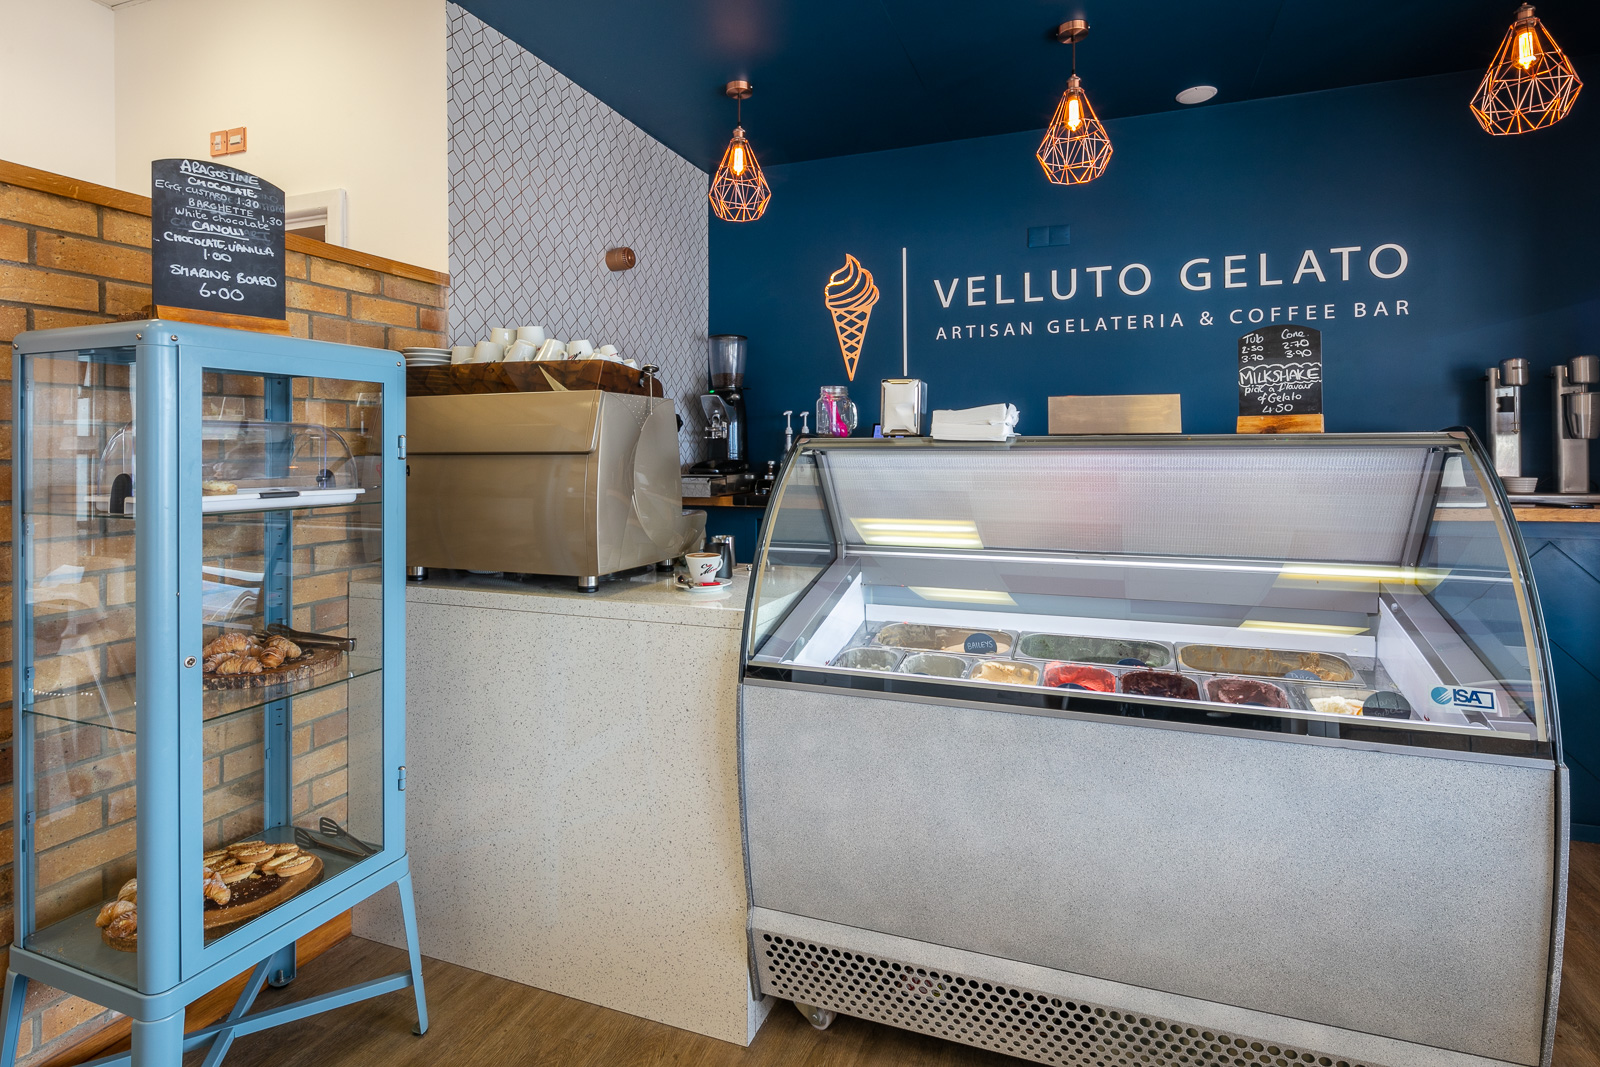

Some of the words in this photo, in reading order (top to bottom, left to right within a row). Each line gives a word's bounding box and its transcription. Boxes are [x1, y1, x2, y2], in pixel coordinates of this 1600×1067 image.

[180, 159, 260, 185] ARAGOSTINE
[155, 179, 181, 191] EGG
[185, 186, 228, 202] CUSTARD
[237, 197, 260, 209] 1.30
[175, 206, 209, 220] White
[212, 214, 271, 231] chocolate
[261, 214, 283, 227] 1.30
[203, 248, 233, 262] 1.00
[169, 263, 232, 282] SHARING
[236, 272, 278, 288] BOARD
[933, 262, 1152, 309] VELLUTO
[1179, 242, 1409, 292] GELATO
[199, 282, 245, 301] 6.00
[935, 320, 1033, 341] ARTISAN
[1046, 312, 1184, 335] GELATERIA
[1199, 310, 1214, 326] &
[1229, 303, 1336, 325] COFFEE
[1354, 299, 1410, 318] BAR
[1242, 333, 1264, 344] Tub
[1241, 354, 1264, 363] 3.70
[1284, 348, 1312, 358] 3.90
[1239, 367, 1320, 385] MILKSHAKE
[1244, 384, 1265, 397] pick
[1257, 392, 1267, 405] of
[1267, 392, 1302, 403] Gelato
[1262, 403, 1294, 413] 4.50
[966, 640, 994, 651] BAILEYS
[1453, 688, 1482, 704] ISA
